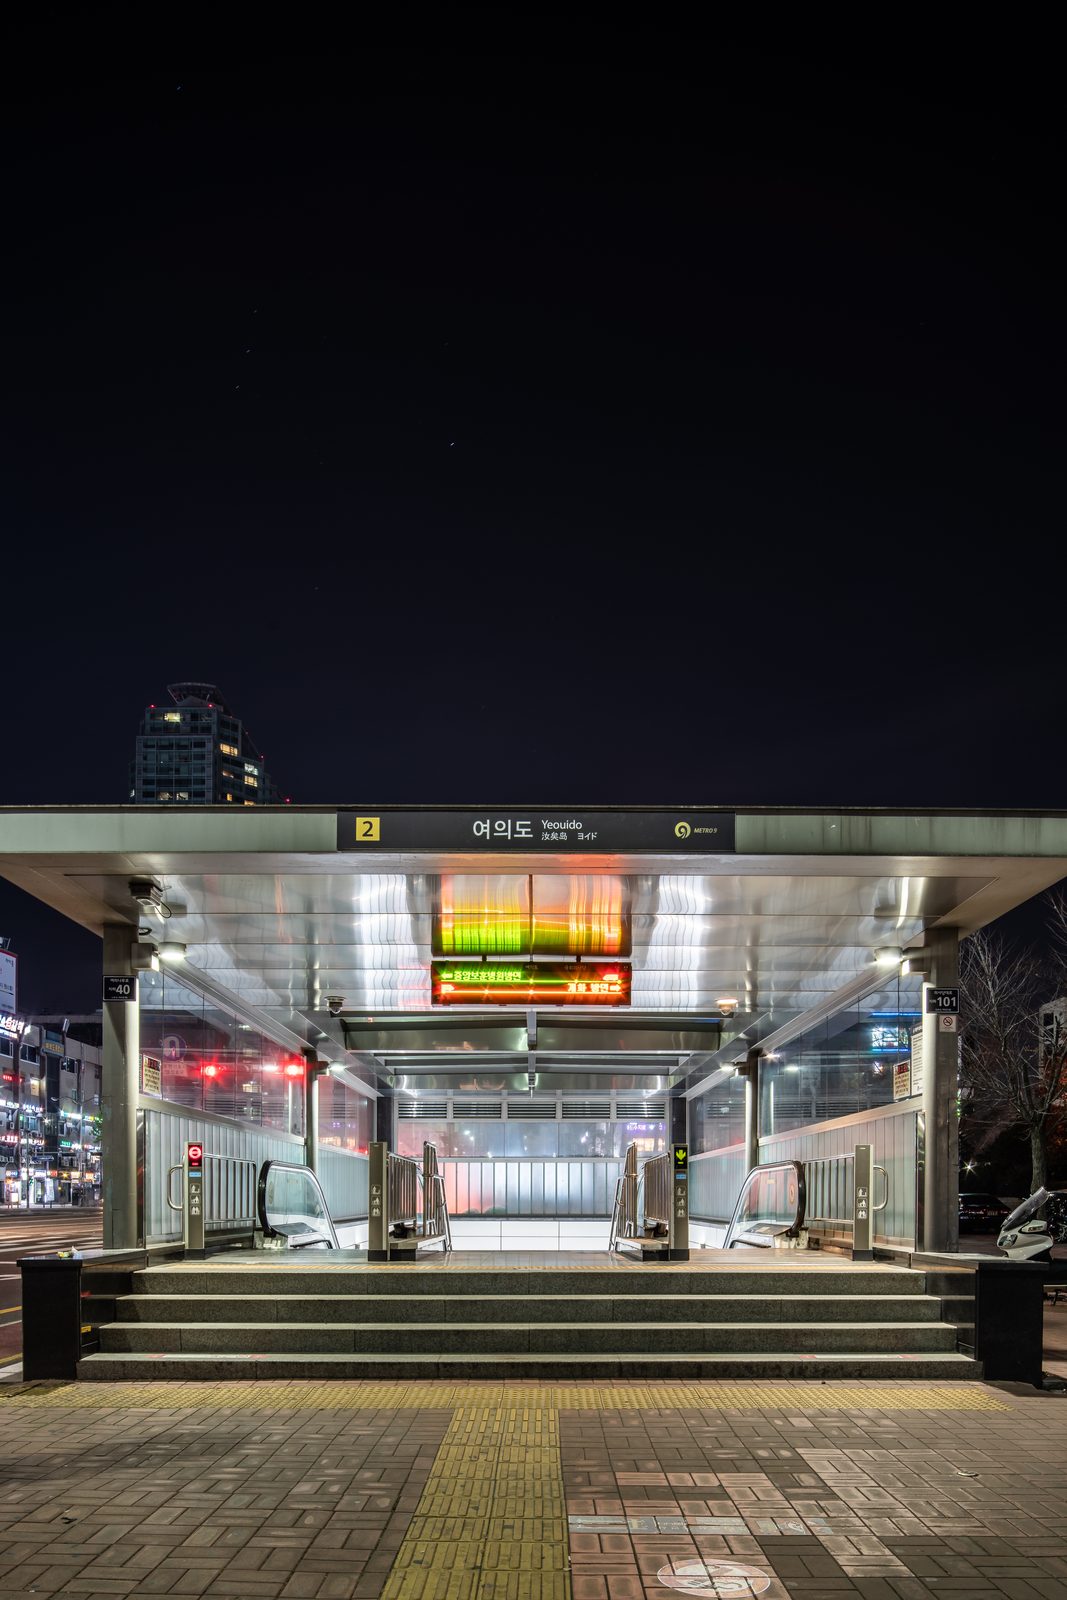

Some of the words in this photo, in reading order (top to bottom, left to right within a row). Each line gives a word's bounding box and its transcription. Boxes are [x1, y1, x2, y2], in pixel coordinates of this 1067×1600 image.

[362, 820, 374, 837] 2
[472, 819, 534, 840] 여의도
[541, 819, 583, 830] Yeouido
[541, 831, 567, 841] 汝矣岛
[577, 831, 597, 841] ヨイド
[115, 984, 131, 995] 40
[936, 996, 956, 1007] 101
